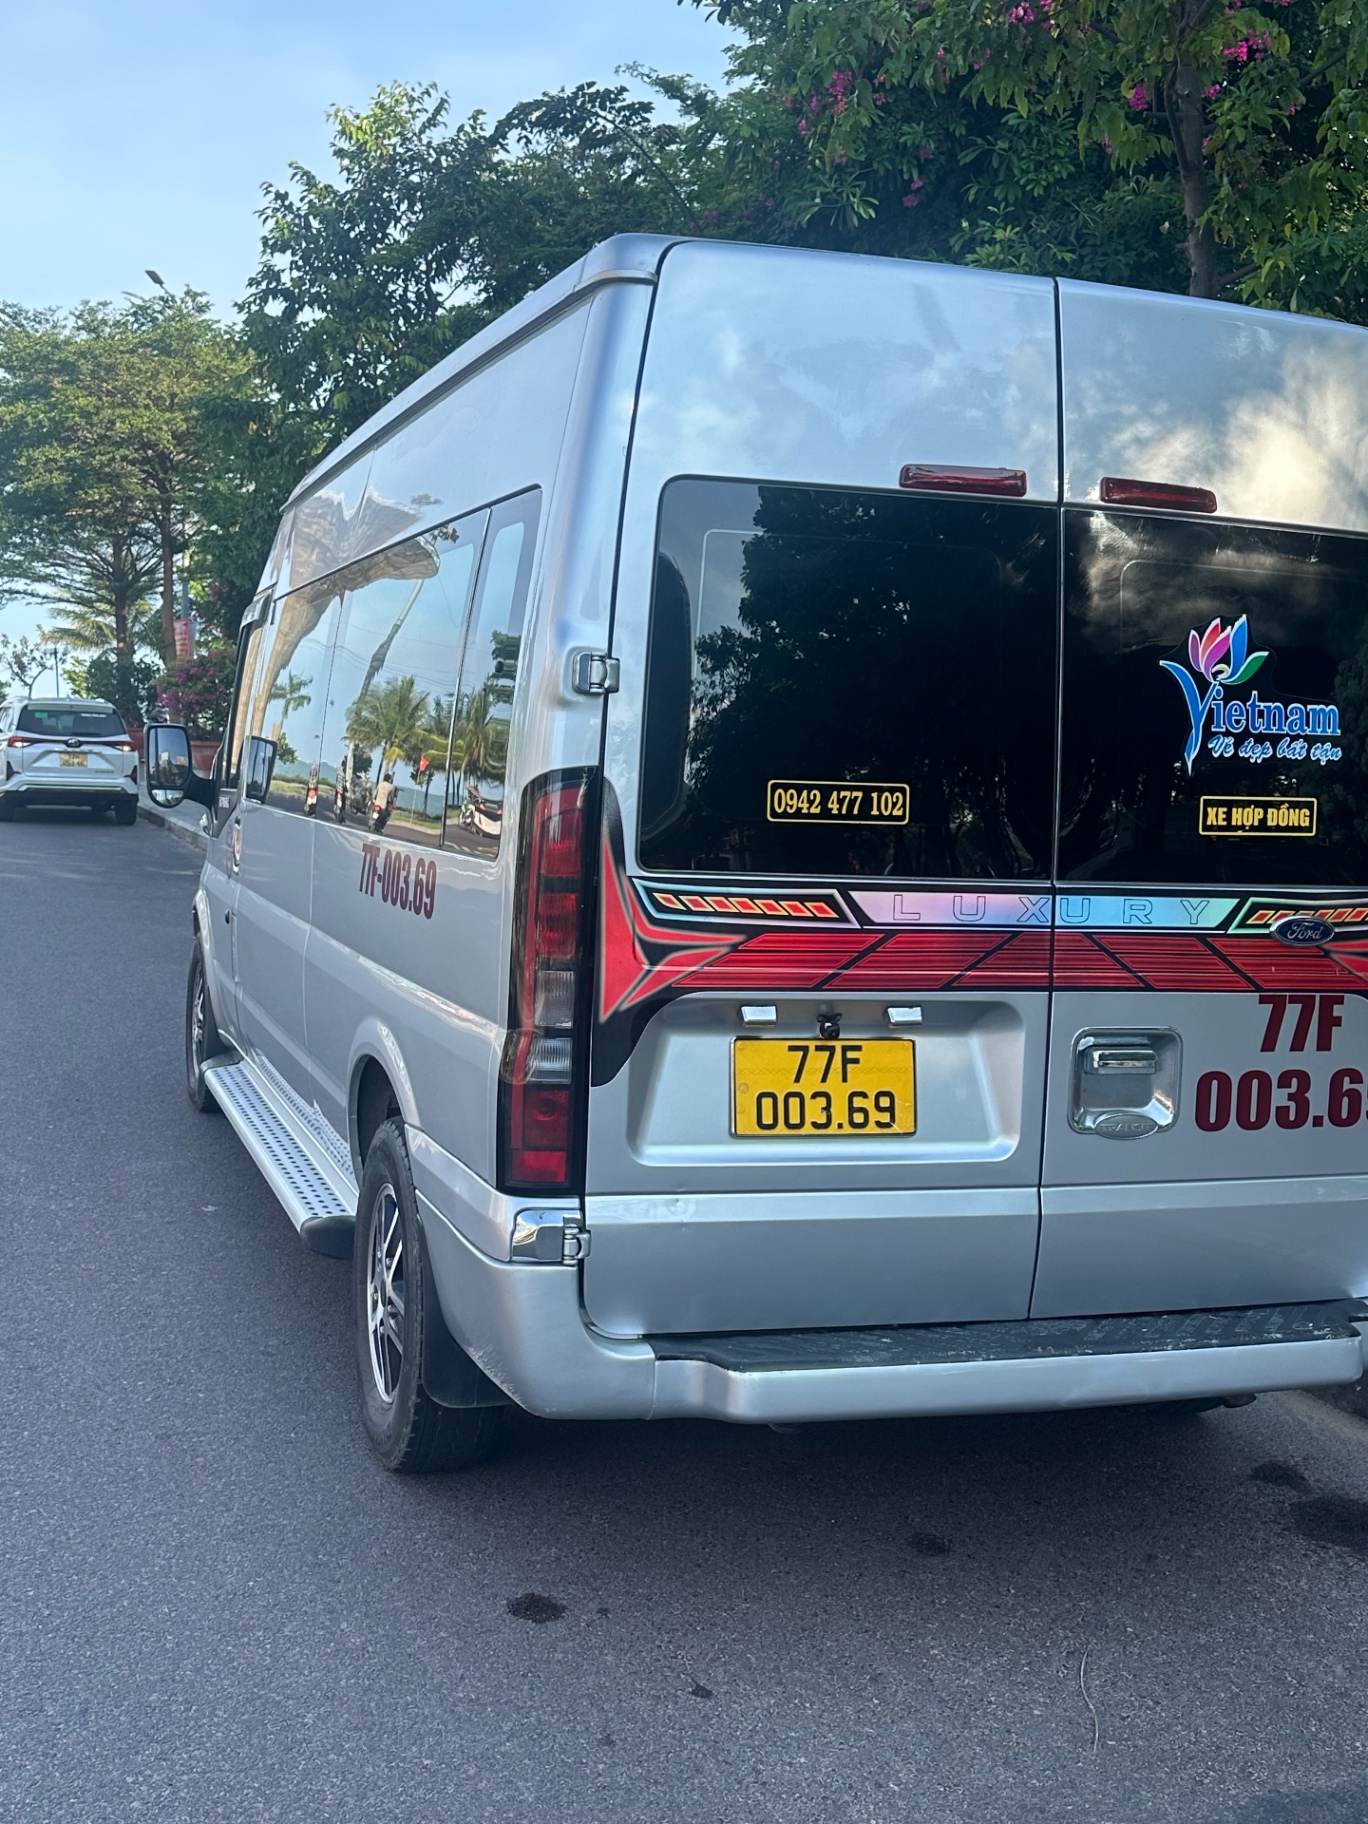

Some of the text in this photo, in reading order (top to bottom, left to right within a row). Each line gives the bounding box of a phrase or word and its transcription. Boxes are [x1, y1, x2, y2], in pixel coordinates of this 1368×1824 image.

[1160, 660, 1341, 777] Vietnam
[1238, 737, 1273, 763] đẹp
[1276, 736, 1308, 760] bất
[1310, 742, 1343, 766] tận
[773, 788, 904, 816] 0942 477 102
[1206, 807, 1227, 826] XE
[1231, 804, 1264, 830] HỢP
[893, 894, 1210, 925] LUXURY
[1287, 921, 1323, 940] Ford
[1258, 994, 1345, 1052] 77F
[787, 1045, 863, 1084] 77F
[756, 1090, 896, 1130] 003.69
[1194, 1067, 1368, 1132] 003.6
